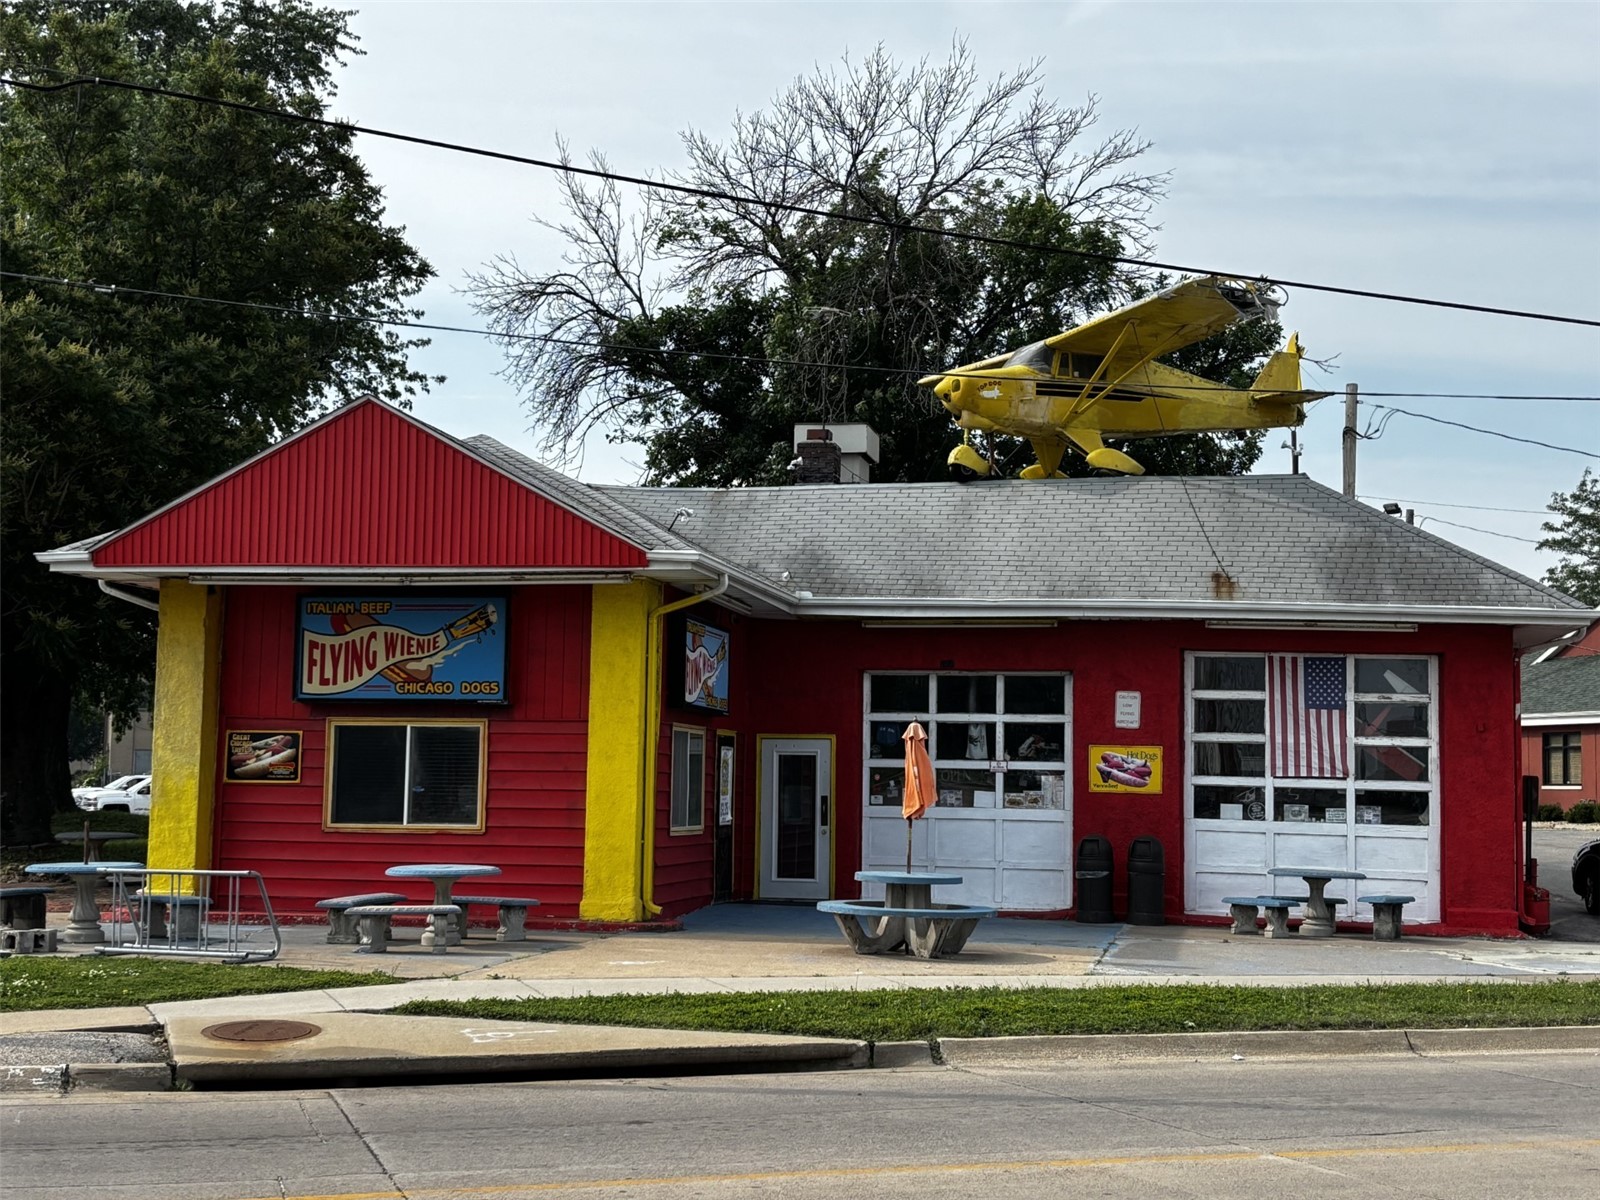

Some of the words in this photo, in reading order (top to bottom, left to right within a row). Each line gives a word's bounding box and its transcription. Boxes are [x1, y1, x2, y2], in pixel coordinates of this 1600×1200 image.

[977, 383, 987, 392] TOP
[306, 602, 355, 614] ITALIAN
[360, 602, 392, 614] BEEF
[307, 631, 378, 686] FLYING
[384, 631, 441, 661] WIENIE
[395, 682, 454, 694] CHICAGO
[460, 682, 500, 694] DOGS
[1126, 751, 1139, 759] Hot
[1140, 751, 1158, 762] Dogs
